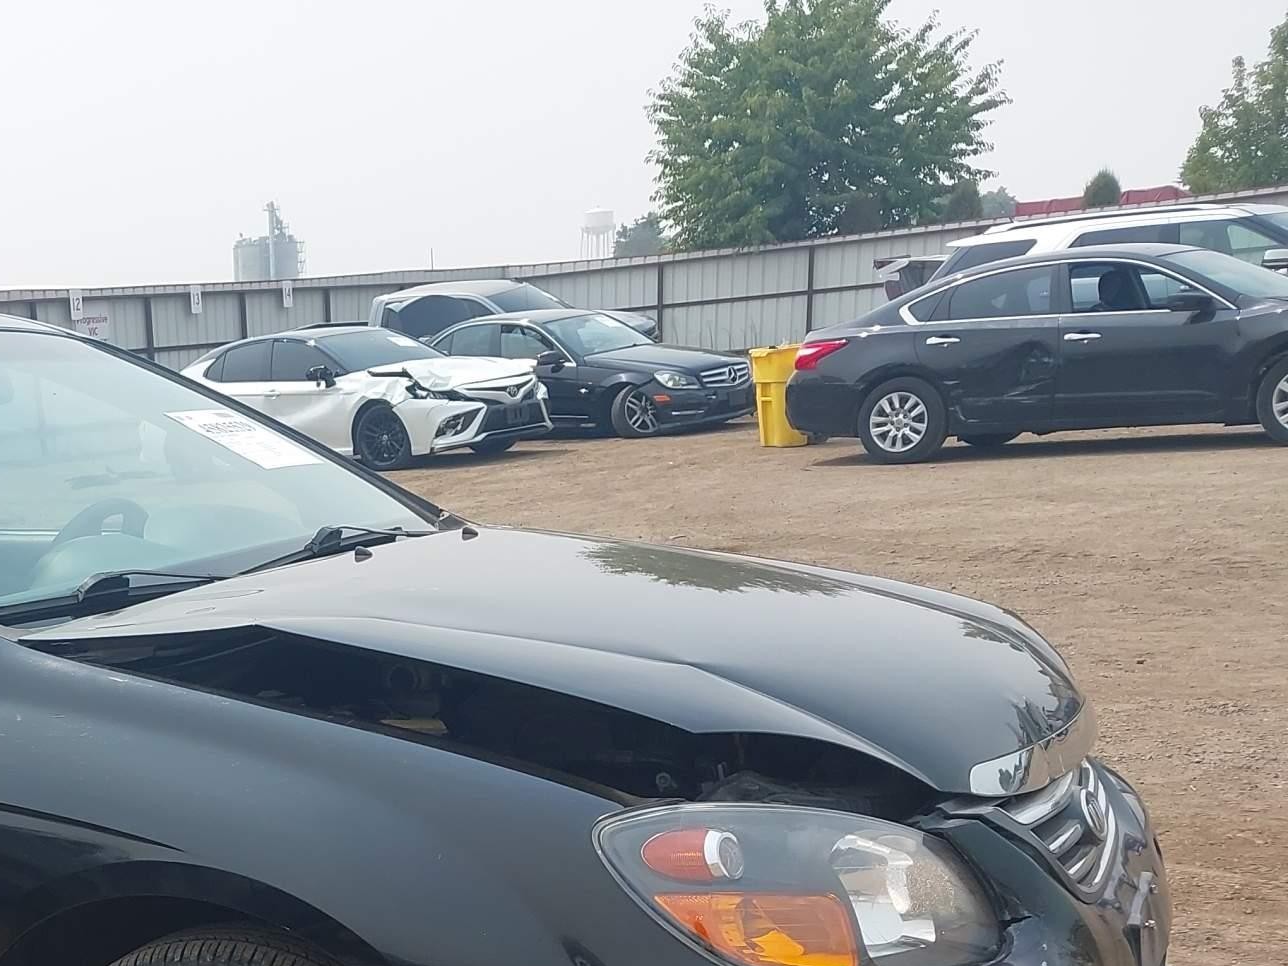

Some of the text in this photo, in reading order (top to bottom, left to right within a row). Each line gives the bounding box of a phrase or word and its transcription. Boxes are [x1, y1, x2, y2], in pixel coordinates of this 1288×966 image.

[193, 292, 200, 305] 13
[285, 287, 291, 299] 14
[72, 297, 81, 311] 12
